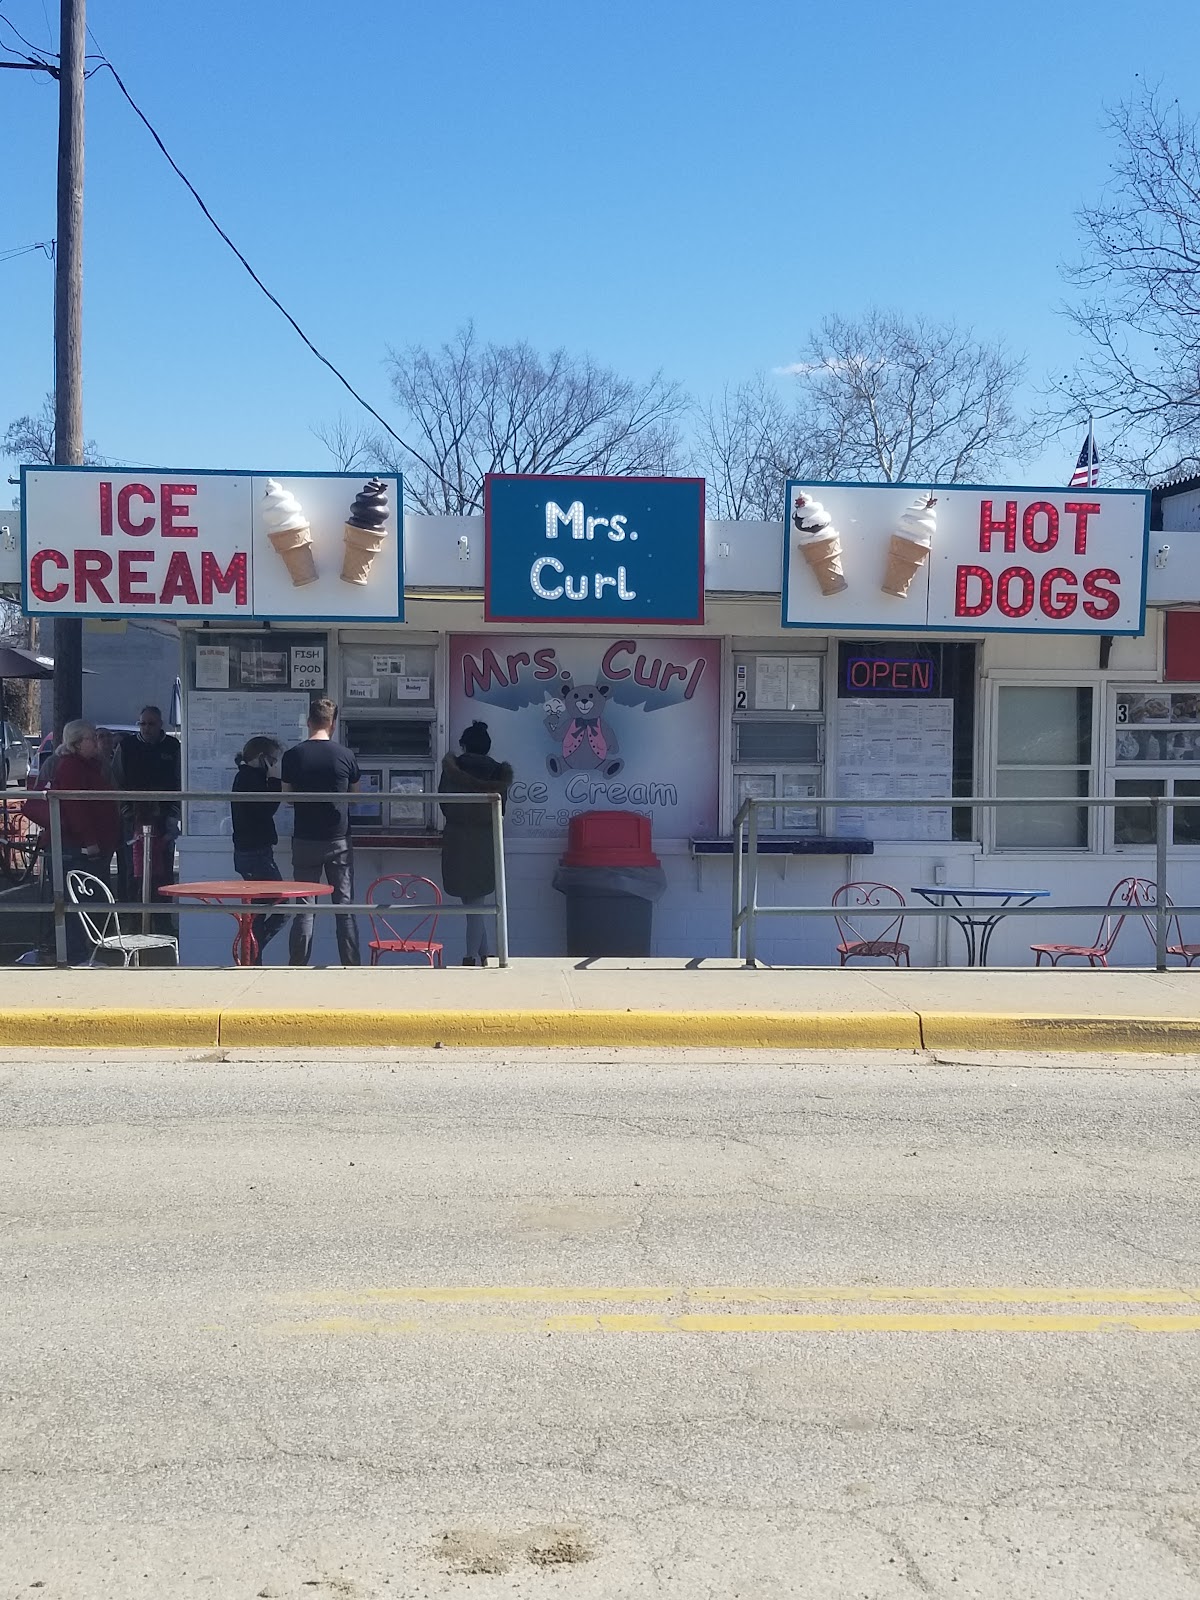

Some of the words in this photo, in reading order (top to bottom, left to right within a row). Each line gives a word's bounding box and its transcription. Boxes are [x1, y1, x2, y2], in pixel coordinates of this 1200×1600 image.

[99, 481, 198, 538] ICE
[544, 500, 639, 542] Mrs.
[979, 500, 1101, 555] HOT
[30, 549, 248, 606] CREAM
[530, 556, 637, 601] Curl
[954, 564, 1121, 620] DOGS
[293, 664, 321, 674] FOOD
[295, 650, 320, 659] FISH
[463, 647, 572, 698] Mrs.
[601, 639, 706, 700] Curl
[851, 661, 930, 689] OPEN
[737, 690, 746, 708] 2
[1118, 704, 1127, 723] 3
[508, 781, 548, 804] ce
[565, 773, 678, 806] Cream
